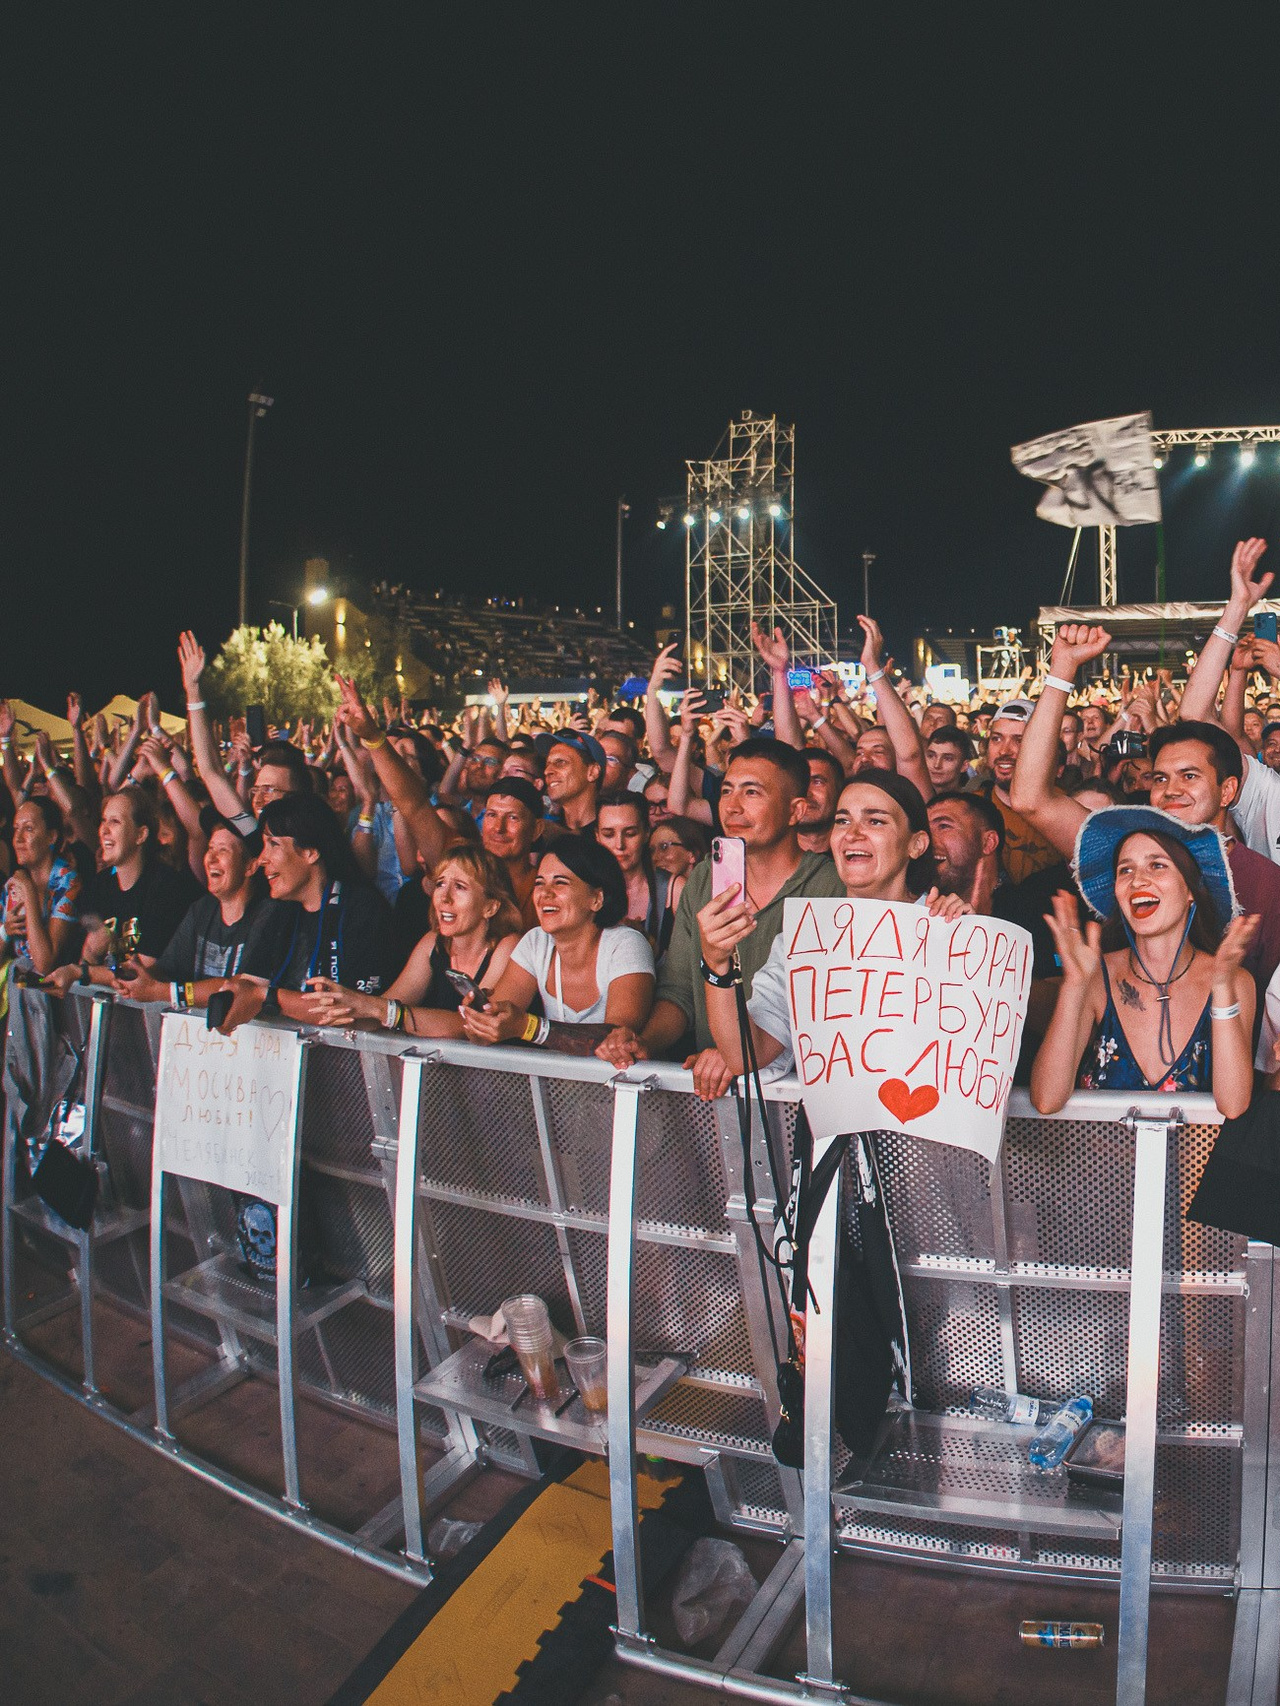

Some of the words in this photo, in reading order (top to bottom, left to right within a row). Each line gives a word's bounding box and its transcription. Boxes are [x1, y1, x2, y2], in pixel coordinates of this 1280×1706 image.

[787, 901, 930, 968] ДЯДЯ
[948, 921, 1029, 1001] ЮРА!
[168, 1064, 258, 1104] МОСКВА
[798, 1028, 894, 1086] ВАС
[905, 1039, 1013, 1116] ЛЮБИ
